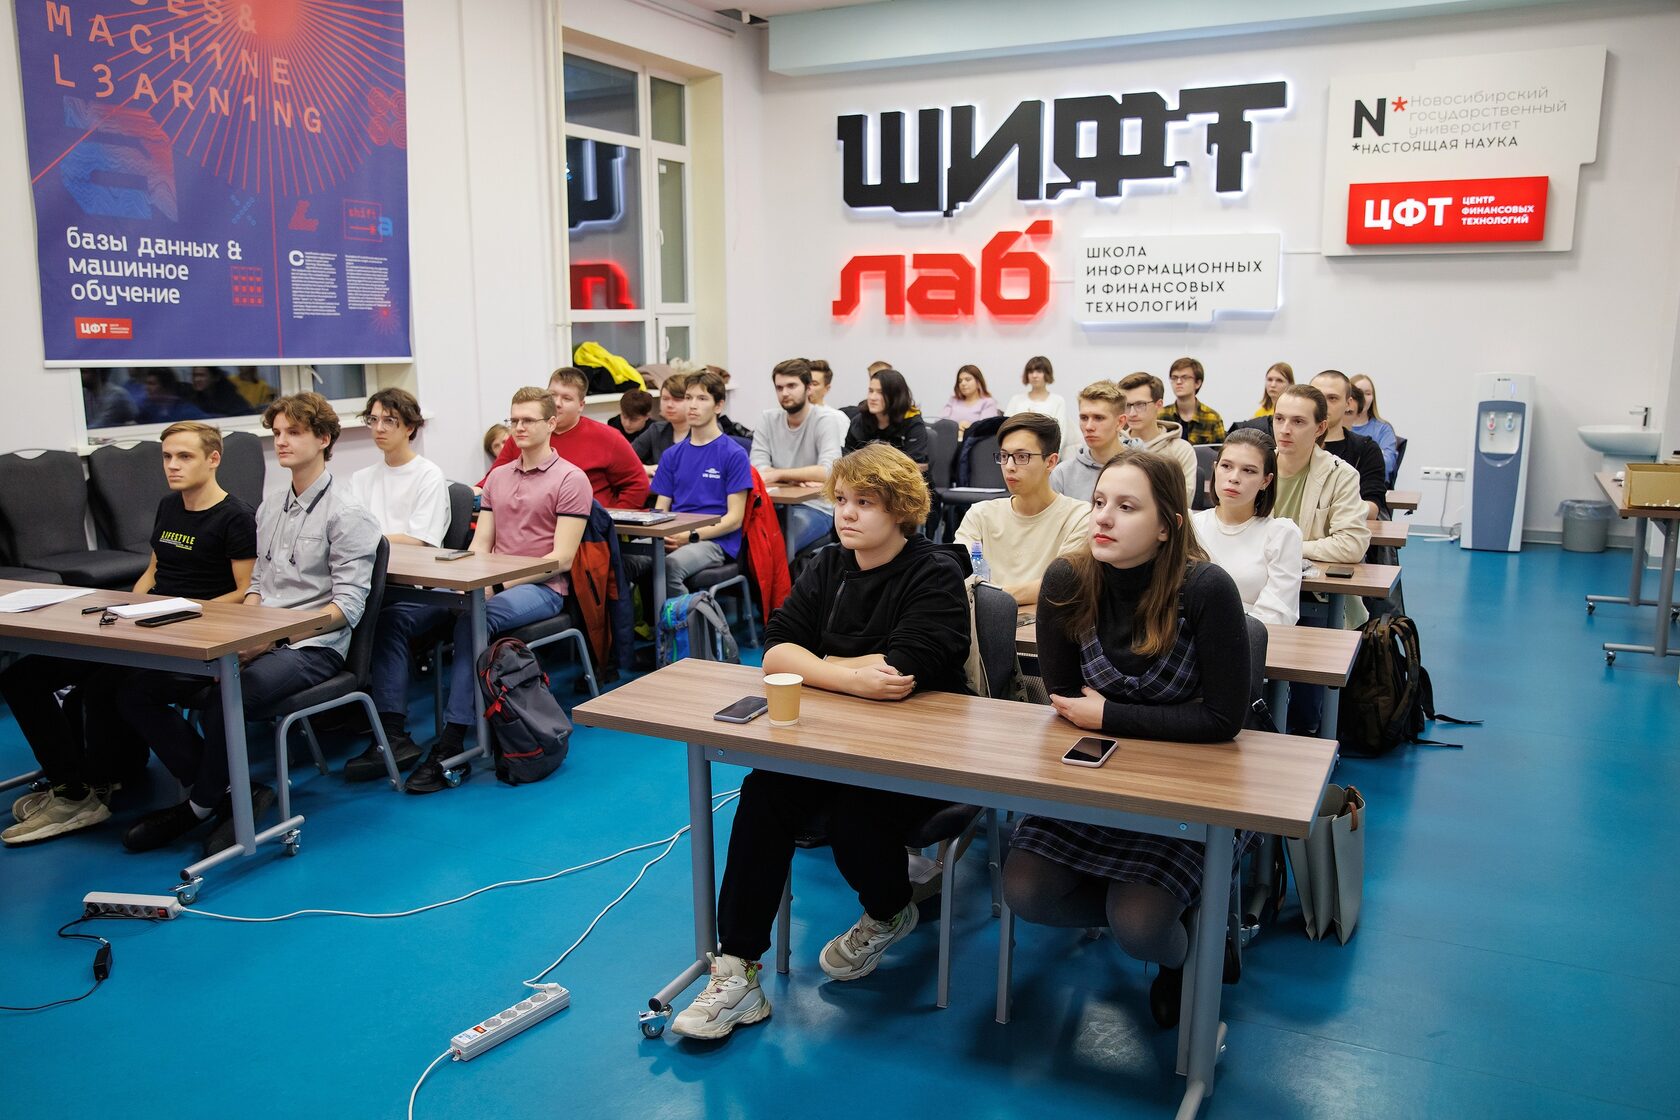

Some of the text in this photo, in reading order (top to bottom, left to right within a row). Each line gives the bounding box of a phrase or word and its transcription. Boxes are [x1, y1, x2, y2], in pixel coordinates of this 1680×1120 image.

[1410, 87, 1549, 106] Новосибирский
[1408, 101, 1567, 121] государственный
[1408, 119, 1520, 139] университет
[837, 81, 1287, 217] ШИФТ
[1464, 136, 1518, 149] НАУКА
[1462, 195, 1496, 205] ЦЕНТР
[1363, 197, 1453, 230] ЦФТ
[1461, 204, 1535, 215] ФИНАНСОВЫХ
[1461, 214, 1529, 226] ТЕХНОЛОГИЙ
[66, 226, 242, 260] базы данных &
[1086, 245, 1147, 259] ШКОЛА
[68, 257, 189, 281] машинное
[1086, 261, 1264, 277] ИНФОРМАЦИОННЫХ
[71, 280, 181, 306] обучение
[1086, 280, 1226, 295] И ФИНАНСОВЫХ
[1086, 297, 1199, 313] ТЕХНОЛОГИЙ
[80, 323, 108, 334] ЦФТ
[161, 530, 195, 545] LIFESTYLE
